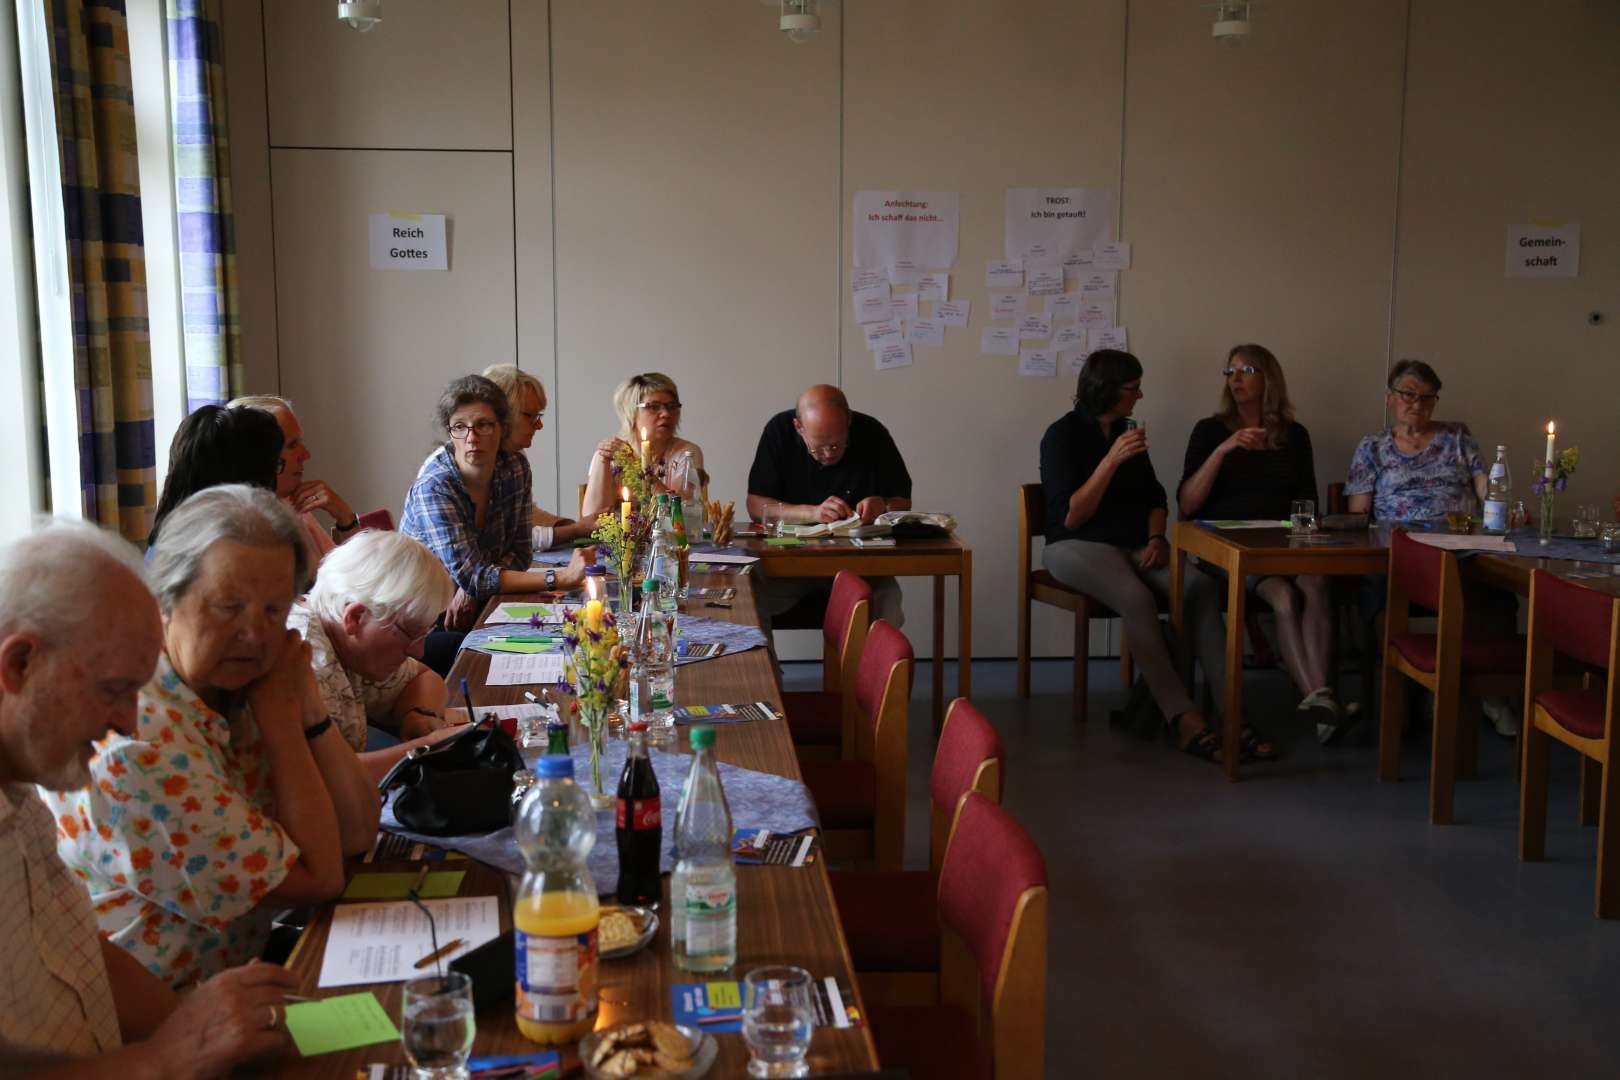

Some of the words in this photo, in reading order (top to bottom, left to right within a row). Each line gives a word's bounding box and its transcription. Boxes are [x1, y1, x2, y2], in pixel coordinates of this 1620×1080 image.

[905, 213, 918, 221] das
[1043, 210, 1055, 218] bin
[392, 227, 424, 239] Reich
[1519, 236, 1567, 248] Gemein-
[389, 247, 428, 259] Gottes
[1524, 255, 1558, 267] schaft
